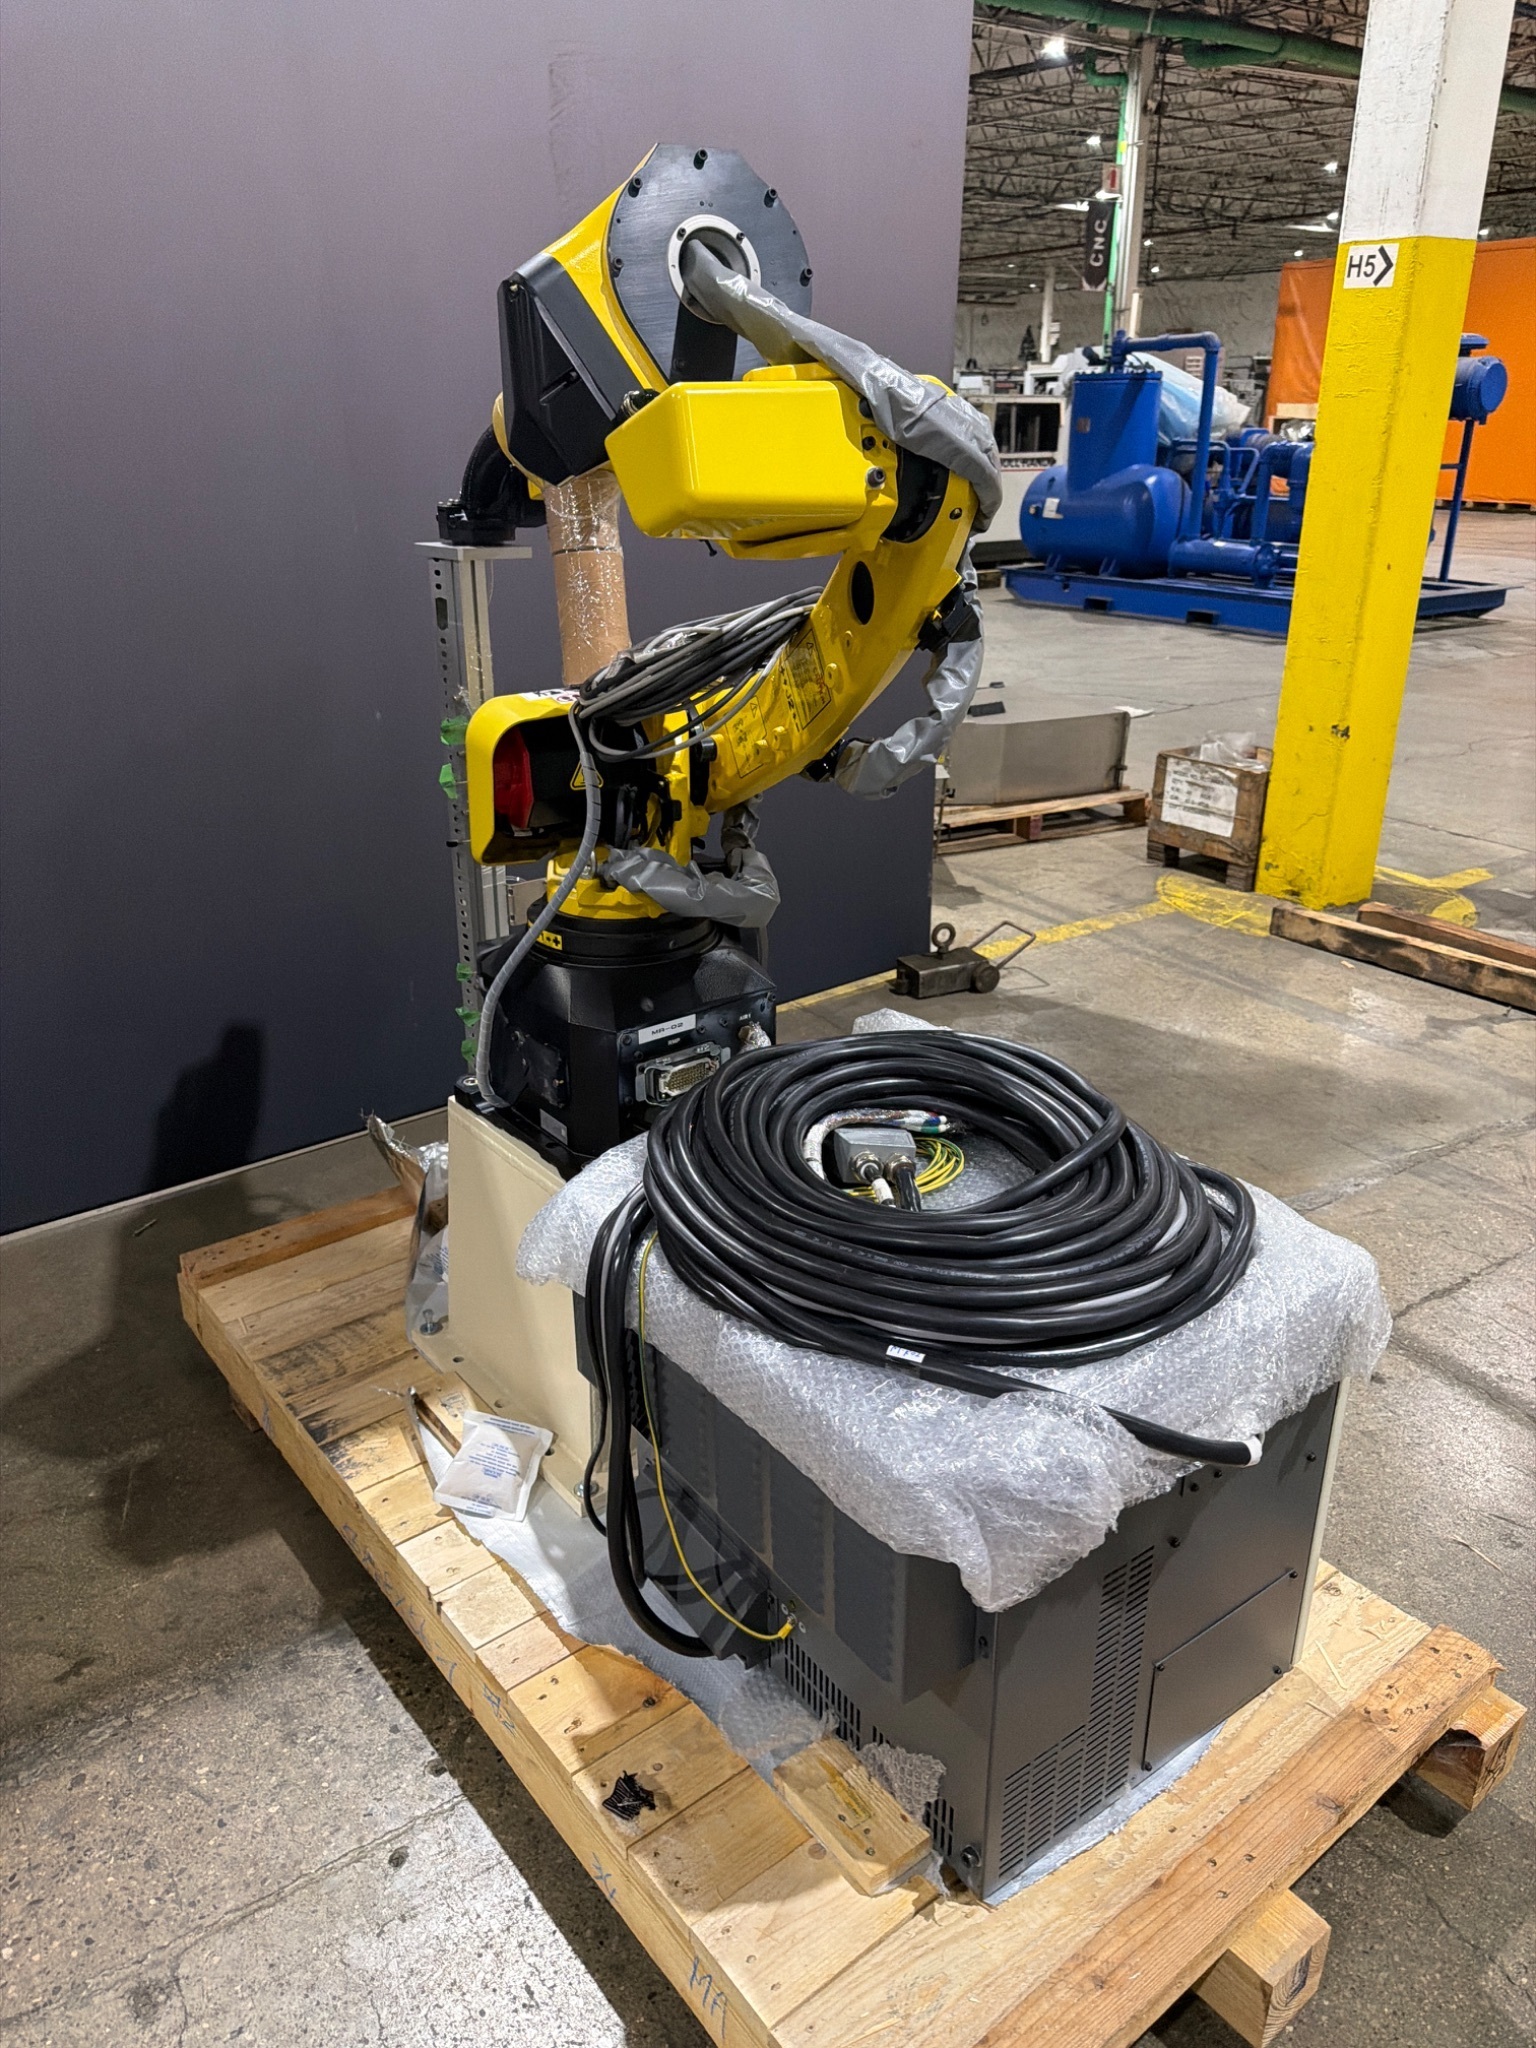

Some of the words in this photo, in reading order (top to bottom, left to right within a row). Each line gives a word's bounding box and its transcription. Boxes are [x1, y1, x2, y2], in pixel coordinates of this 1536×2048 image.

[1089, 220, 1107, 267] CNC
[1346, 255, 1376, 278] H5
[651, 1022, 684, 1036] MR-02
